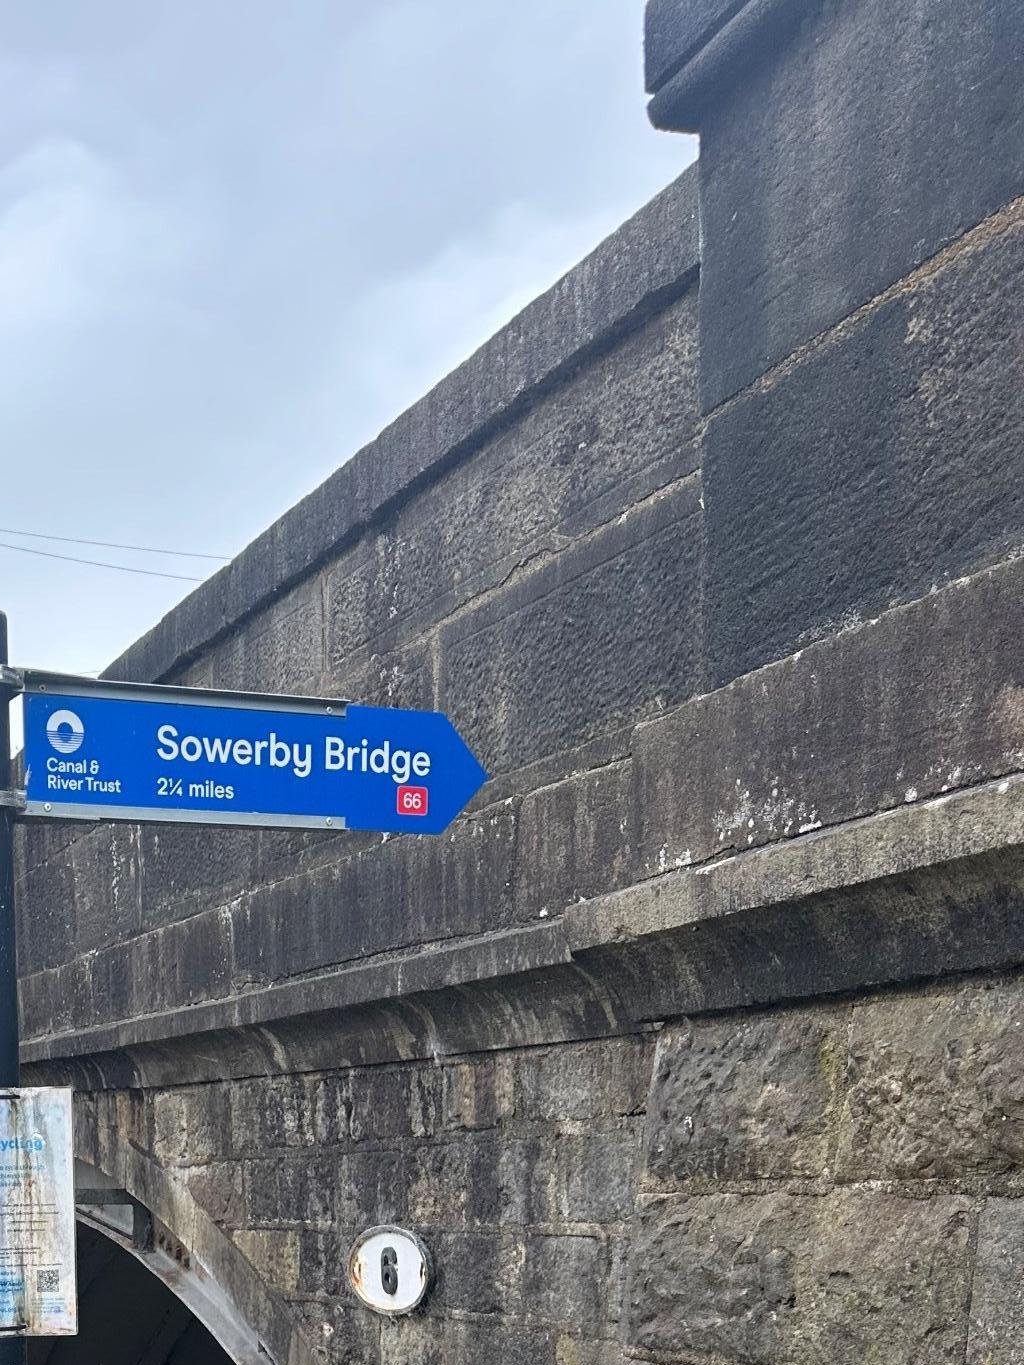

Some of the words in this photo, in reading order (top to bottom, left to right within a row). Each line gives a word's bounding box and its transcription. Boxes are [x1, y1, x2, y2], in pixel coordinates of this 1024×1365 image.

[156, 724, 312, 778] Sowerby
[325, 736, 431, 784] Bridge
[46, 757, 87, 774] Canal
[89, 759, 100, 774] &
[47, 774, 84, 791] River
[84, 776, 122, 793] Trust
[188, 779, 235, 800] miles
[403, 792, 422, 809] 66
[380, 1246, 398, 1296] 6
